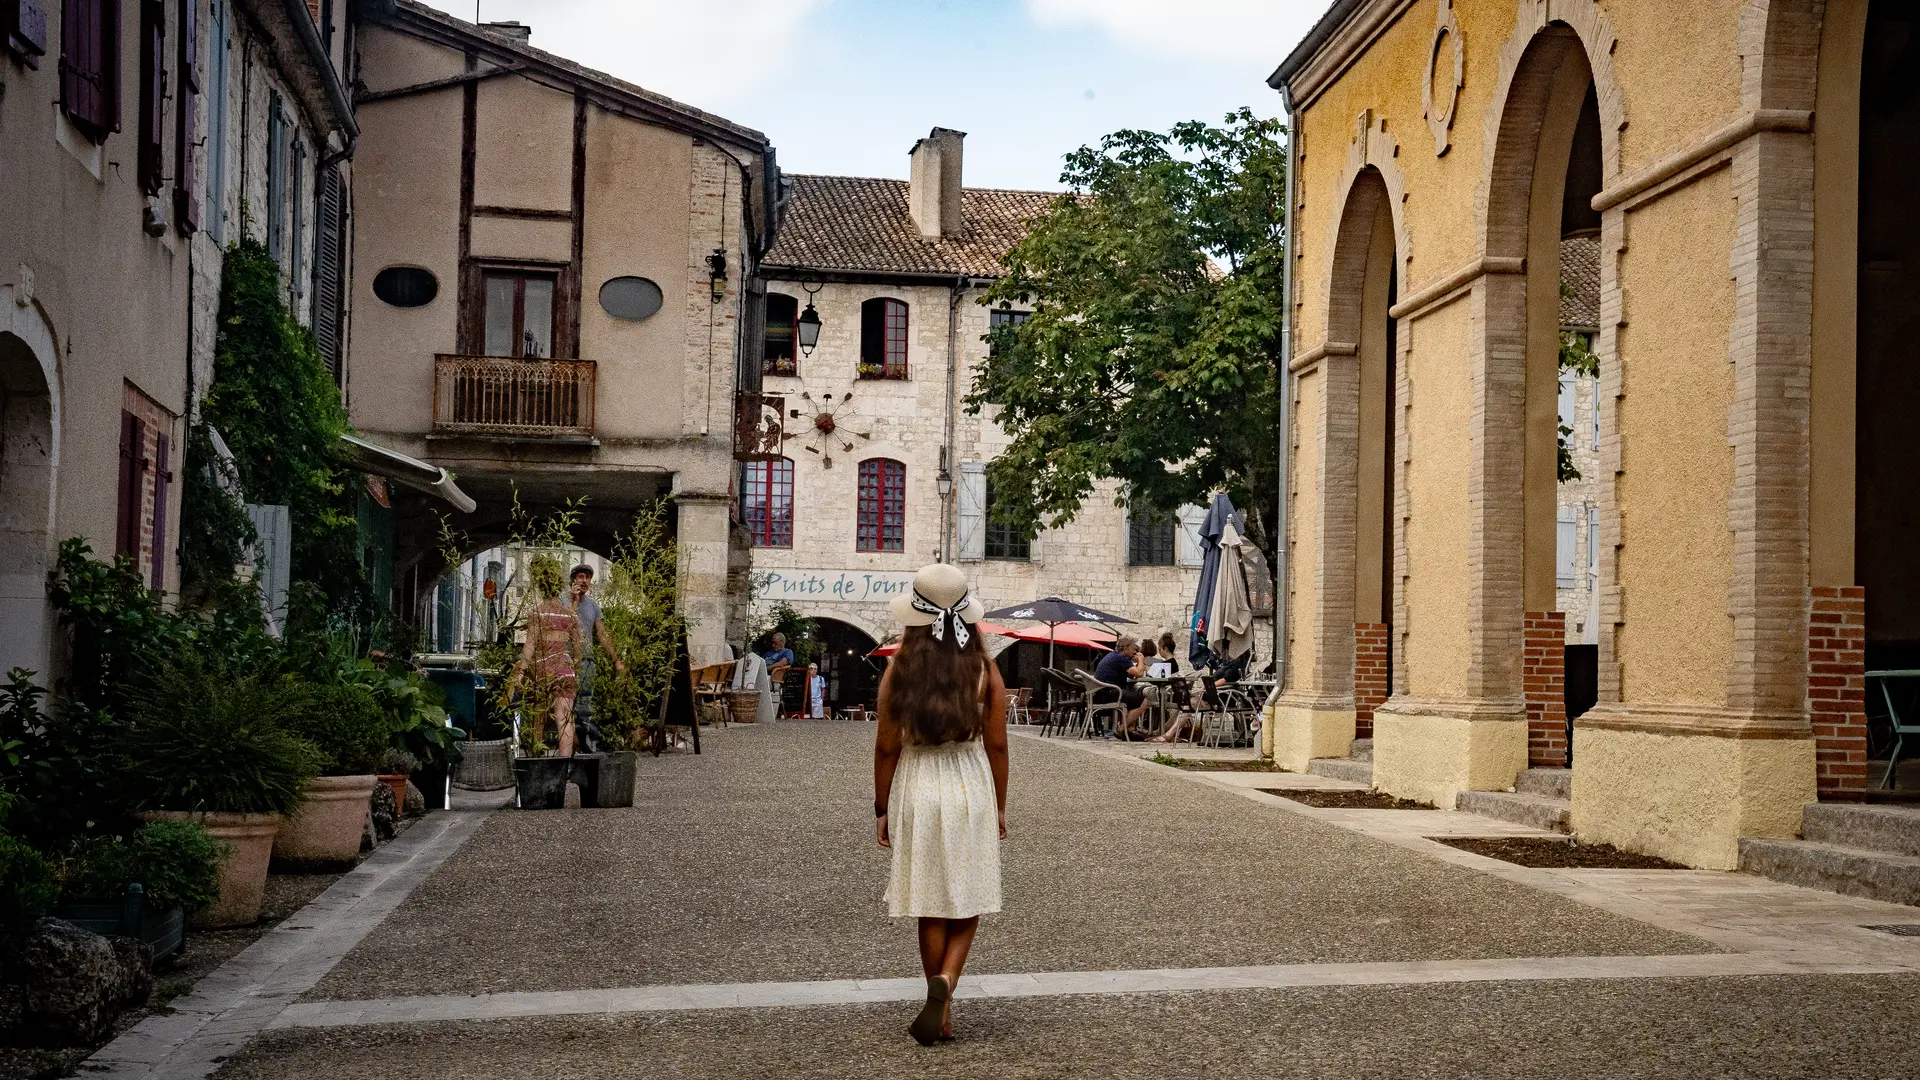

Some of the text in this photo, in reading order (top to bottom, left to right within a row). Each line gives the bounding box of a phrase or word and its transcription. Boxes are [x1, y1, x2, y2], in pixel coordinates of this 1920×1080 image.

[763, 572, 909, 601] Puits de Jour
